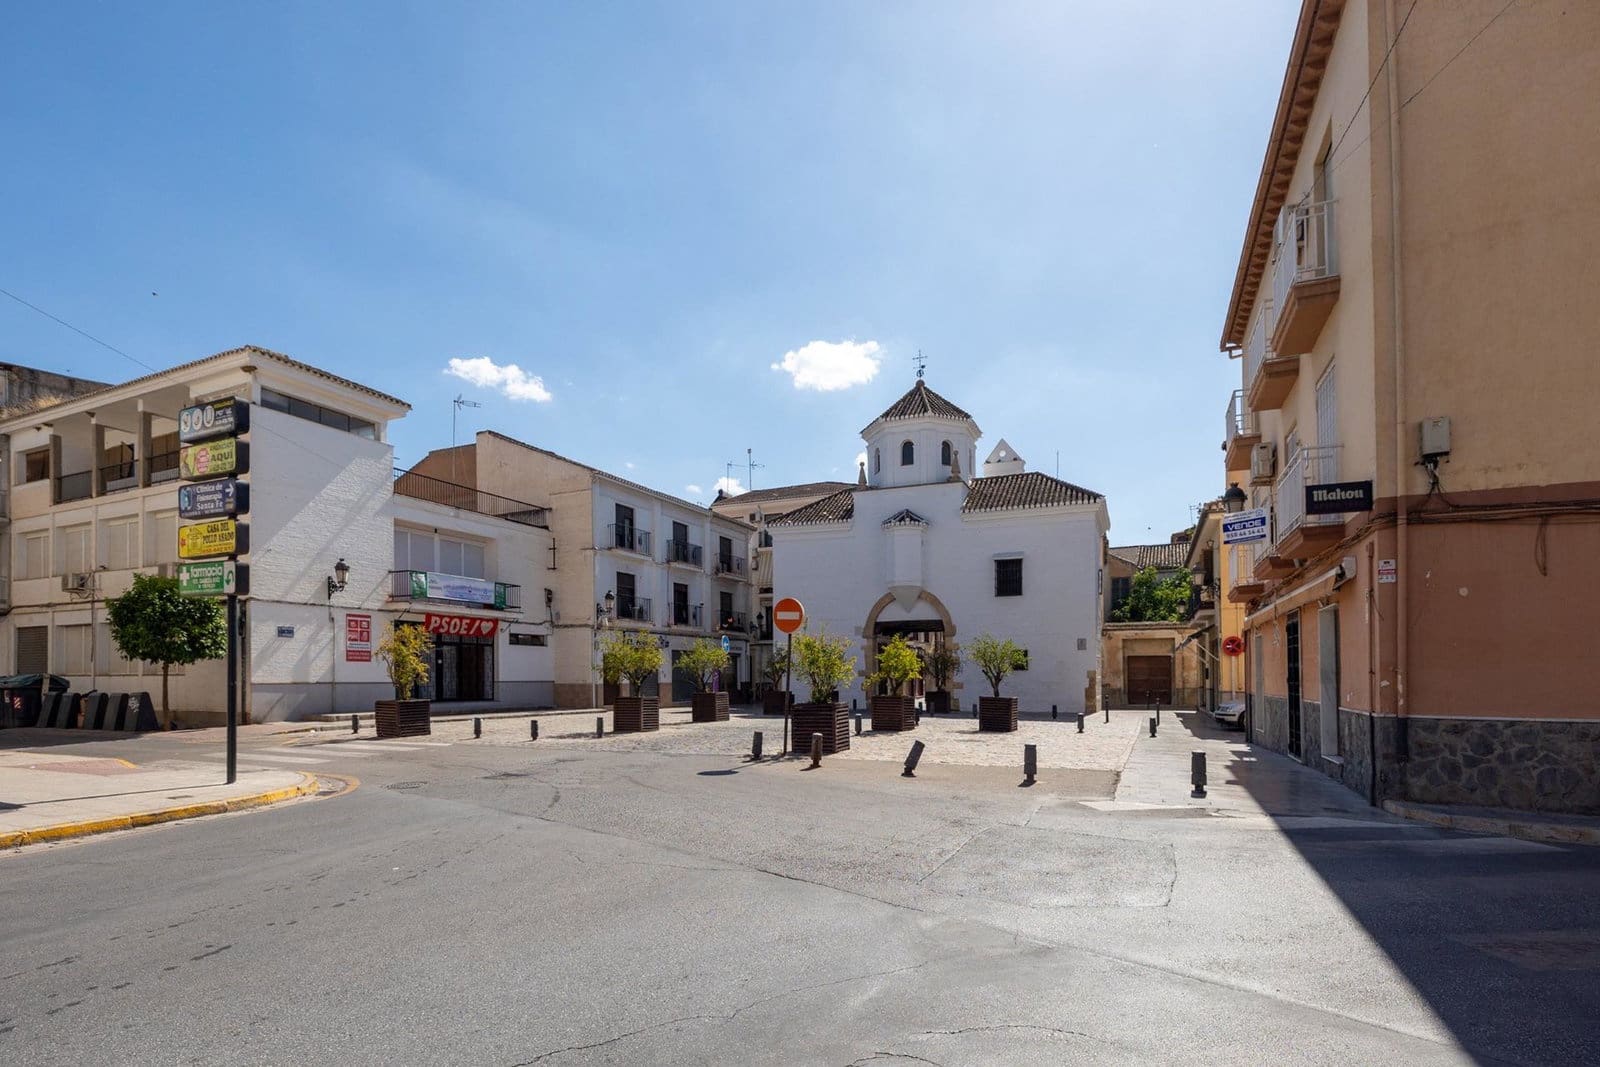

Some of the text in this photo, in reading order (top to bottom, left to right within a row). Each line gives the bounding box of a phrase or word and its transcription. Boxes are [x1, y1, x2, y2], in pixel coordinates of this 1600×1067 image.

[196, 502, 214, 511] Santa
[1227, 519, 1262, 531] VENDE
[190, 563, 223, 578] farmacia
